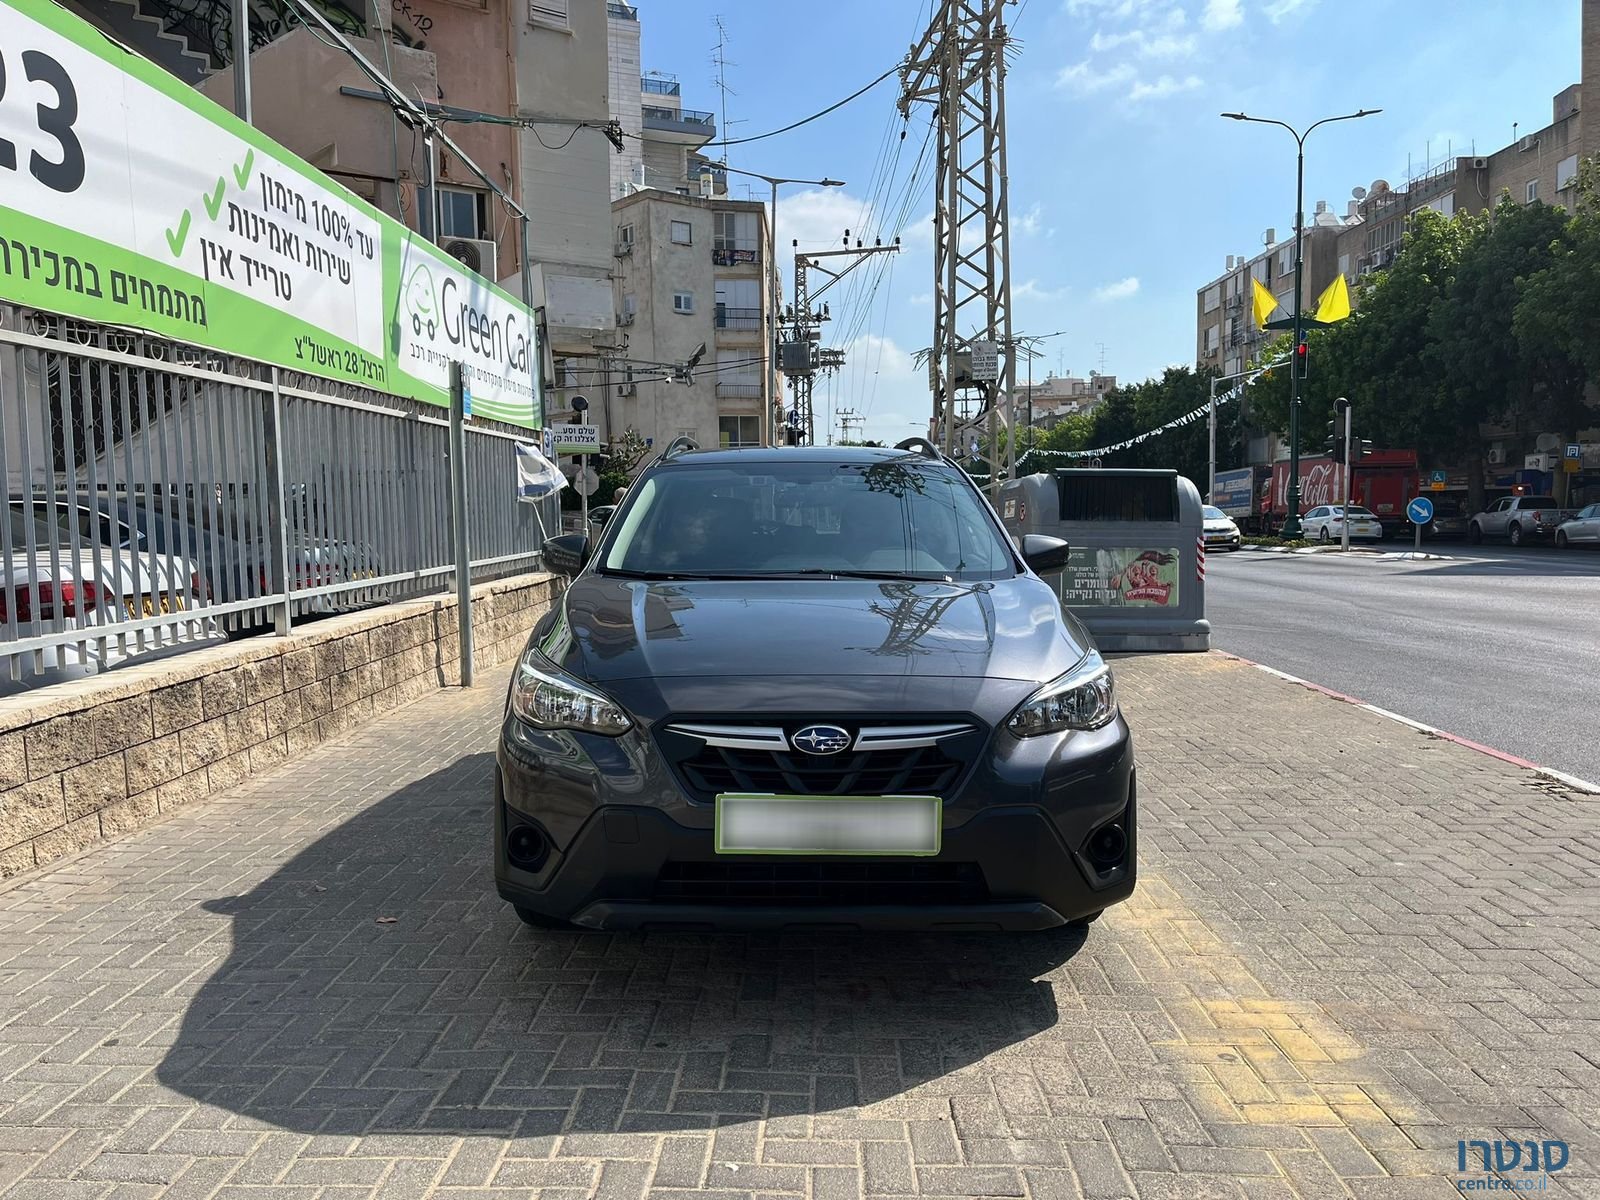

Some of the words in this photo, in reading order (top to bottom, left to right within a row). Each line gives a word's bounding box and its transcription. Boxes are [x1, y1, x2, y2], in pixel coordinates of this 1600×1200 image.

[259, 171, 307, 225] מימון
[227, 200, 301, 263] ואמינות
[312, 200, 354, 250] 100%
[357, 229, 374, 261] עד
[199, 237, 234, 282] אין
[239, 253, 292, 302] טרייד
[305, 239, 351, 285] שירות
[110, 269, 207, 327] מתמחים
[441, 277, 503, 364] Green
[505, 313, 531, 375] Car
[344, 350, 359, 375] 28
[361, 353, 385, 384] הרצל
[410, 343, 425, 361] רכב
[575, 434, 596, 443] אצלנו
[578, 427, 595, 435] שלם
